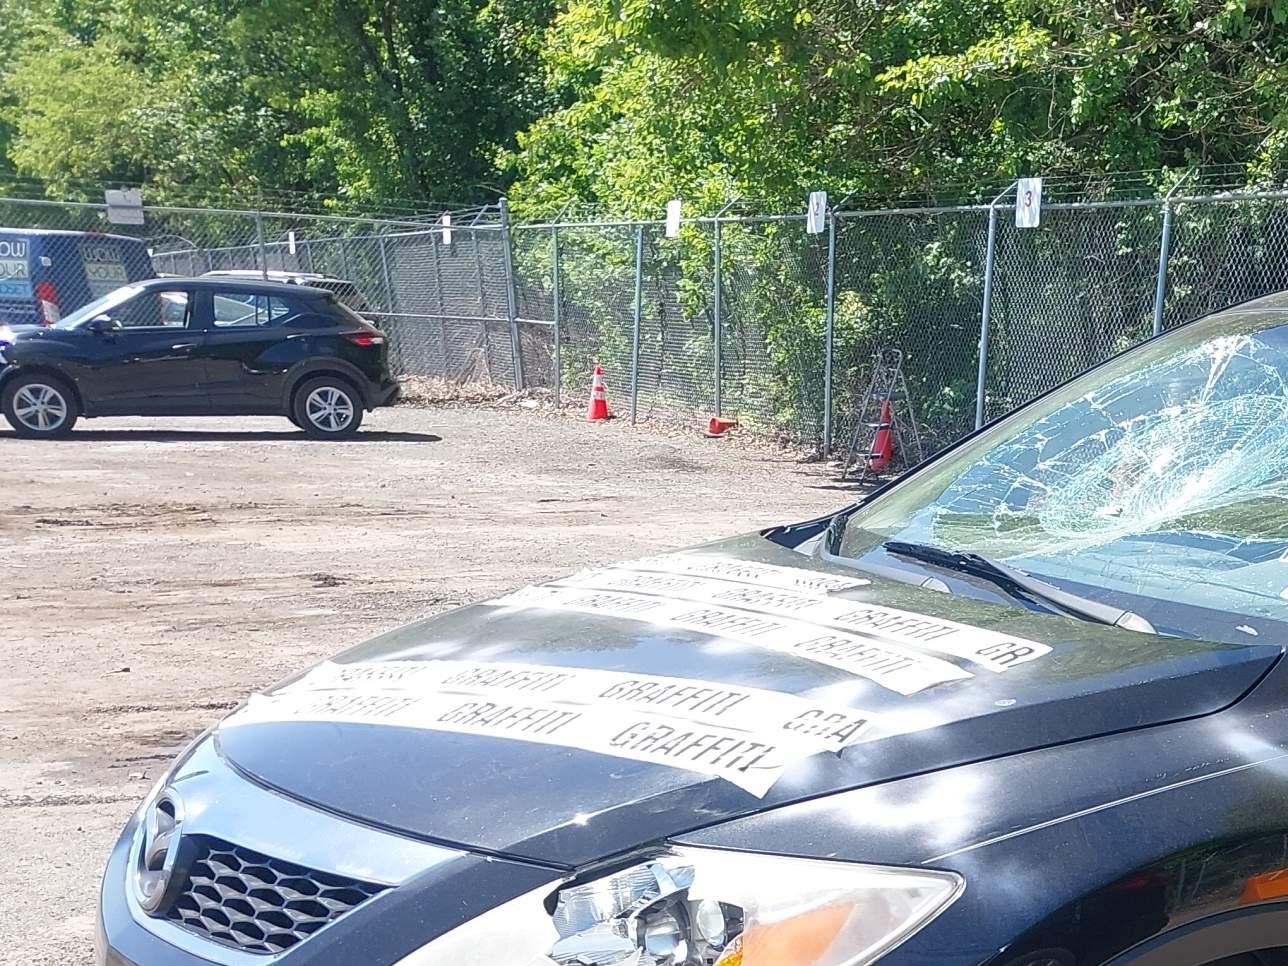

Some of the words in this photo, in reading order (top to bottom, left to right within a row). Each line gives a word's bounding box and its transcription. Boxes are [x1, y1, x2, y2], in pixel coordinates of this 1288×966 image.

[1025, 190, 1032, 207] 3
[670, 609, 787, 637] GRAFFITI
[833, 609, 960, 641] GRAFFITI
[441, 667, 577, 692] GRAFFITI
[598, 680, 751, 716] GRAFFITI
[437, 702, 583, 735] GRAFFITI
[609, 721, 777, 773] GRAFFITI
